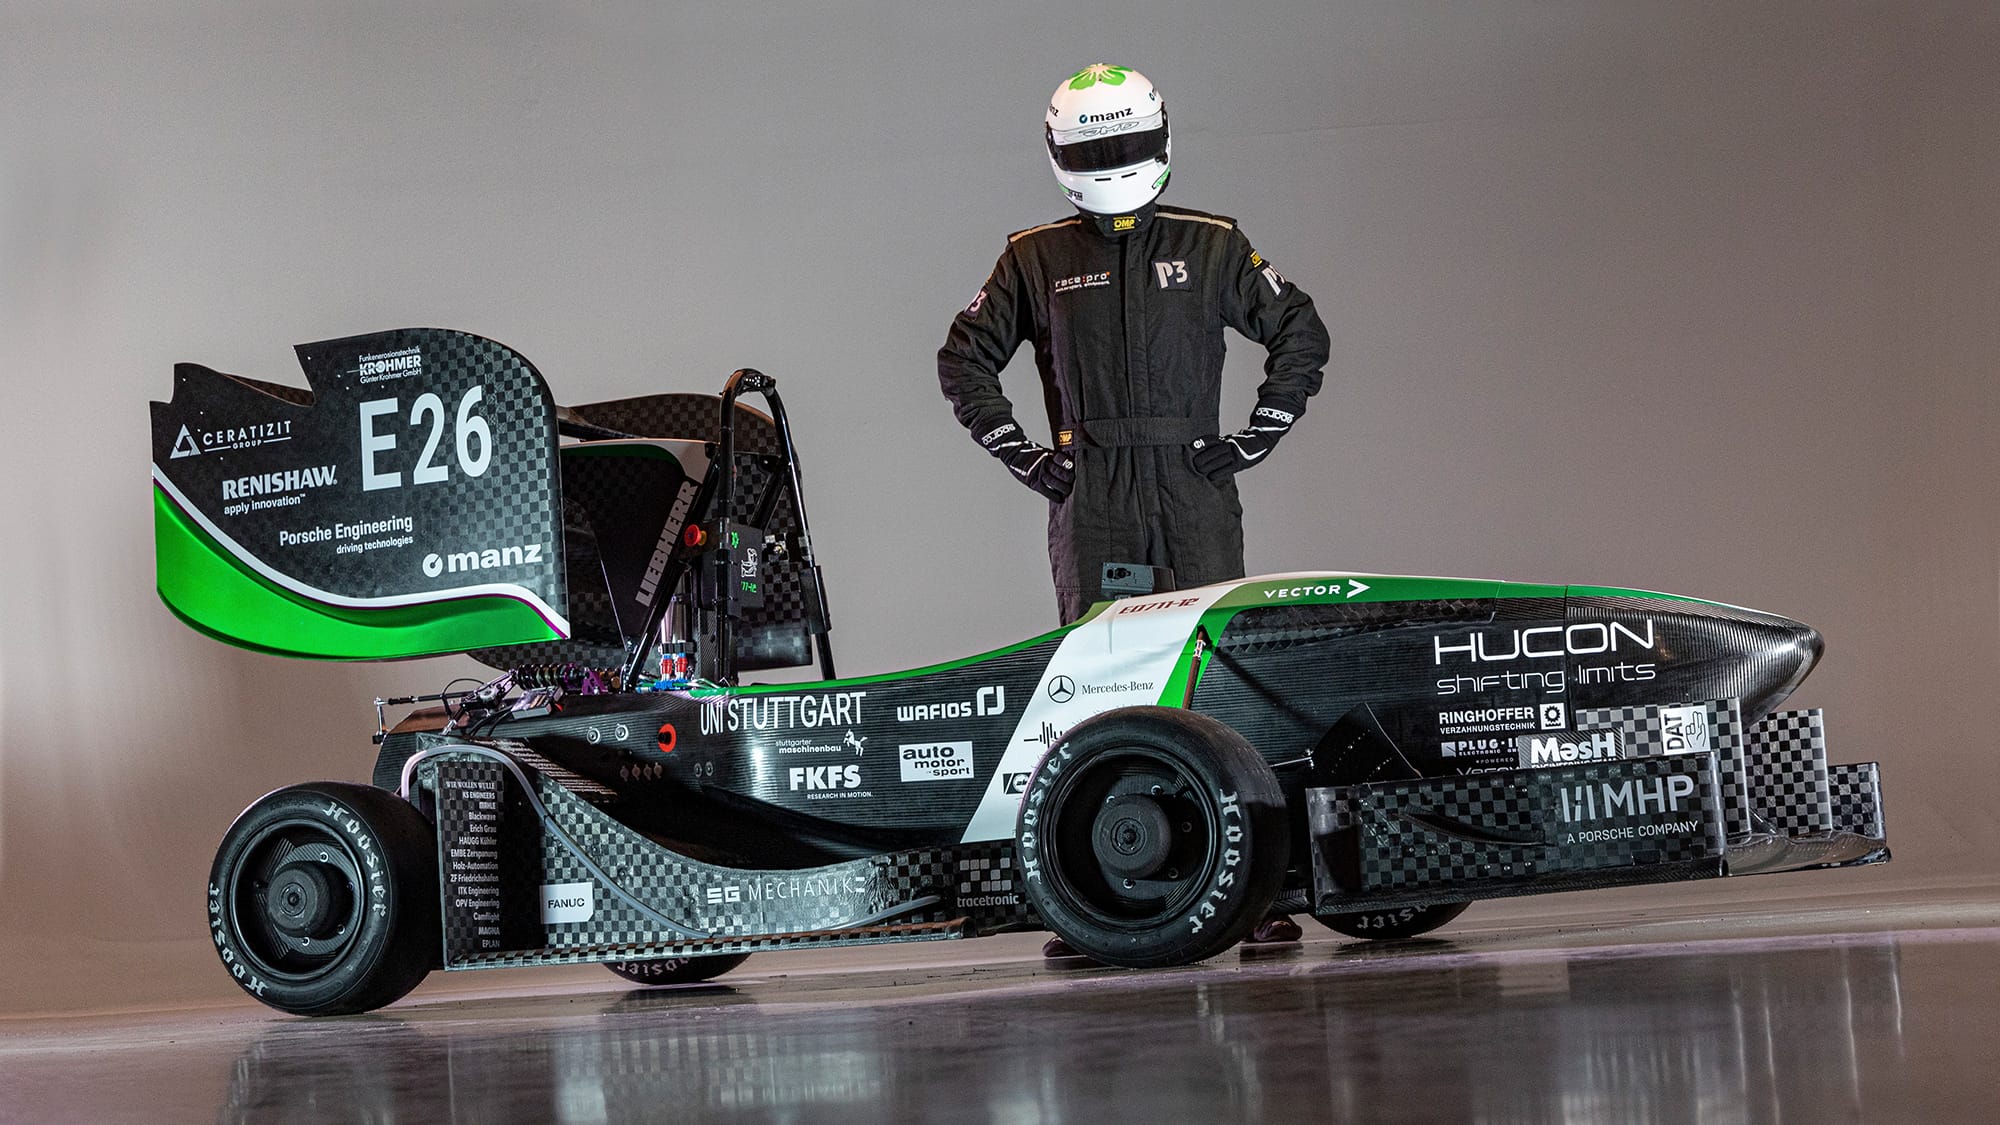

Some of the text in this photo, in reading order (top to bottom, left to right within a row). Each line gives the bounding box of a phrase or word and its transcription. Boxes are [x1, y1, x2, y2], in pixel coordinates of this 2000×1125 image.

[1090, 107, 1133, 122] manz
[1114, 219, 1135, 229] OMP
[1155, 260, 1188, 289] P3
[360, 354, 421, 376] KROHMER
[402, 367, 422, 377] GmbH
[202, 420, 292, 446] CERATIZIT
[359, 385, 493, 492] E26
[232, 439, 262, 450] GROUP
[224, 501, 250, 516] apply
[279, 514, 413, 546] Porsche Engineering
[336, 534, 414, 555] driving technologies
[635, 481, 699, 607] LIEBHERR
[447, 543, 543, 573] manz
[1263, 584, 1341, 599] VECTOR
[1434, 619, 1654, 665] HUCON
[1436, 662, 1656, 695] shifting limits
[1082, 681, 1154, 695] Mercedes-Benz
[700, 691, 867, 736] UNI STUTTGART
[897, 701, 972, 721] WAFIOS
[1439, 706, 1535, 724] RINGHOFFER
[1440, 721, 1535, 734] VERZAHNUNGSTECHNIK
[1666, 713, 1685, 752] DAT
[775, 738, 812, 748] stuttgarter
[778, 744, 842, 754] maschinenbau
[902, 746, 955, 760] auto
[914, 758, 965, 769] motor
[789, 764, 862, 791] FKFS
[806, 792, 839, 800] RESEARCH
[840, 791, 846, 799] IN
[1602, 775, 1694, 818] MHP
[469, 824, 483, 833] Erich
[1566, 820, 1699, 845] A PORSCHE COMPANY
[458, 836, 479, 845] HAUGG
[322, 801, 387, 917] Hoosier
[450, 848, 466, 858] EMBE
[1188, 788, 1244, 934] Hoosier
[452, 861, 499, 870] Holz-Automation
[450, 873, 499, 883] ZF Friedrichshafen
[457, 885, 500, 896] ITK Engineering
[748, 877, 853, 901] MECHANIK
[468, 898, 500, 910] Engineering
[547, 897, 585, 909] FANUC
[957, 892, 1020, 908] tracetronic
[208, 882, 270, 997] Hoosier
